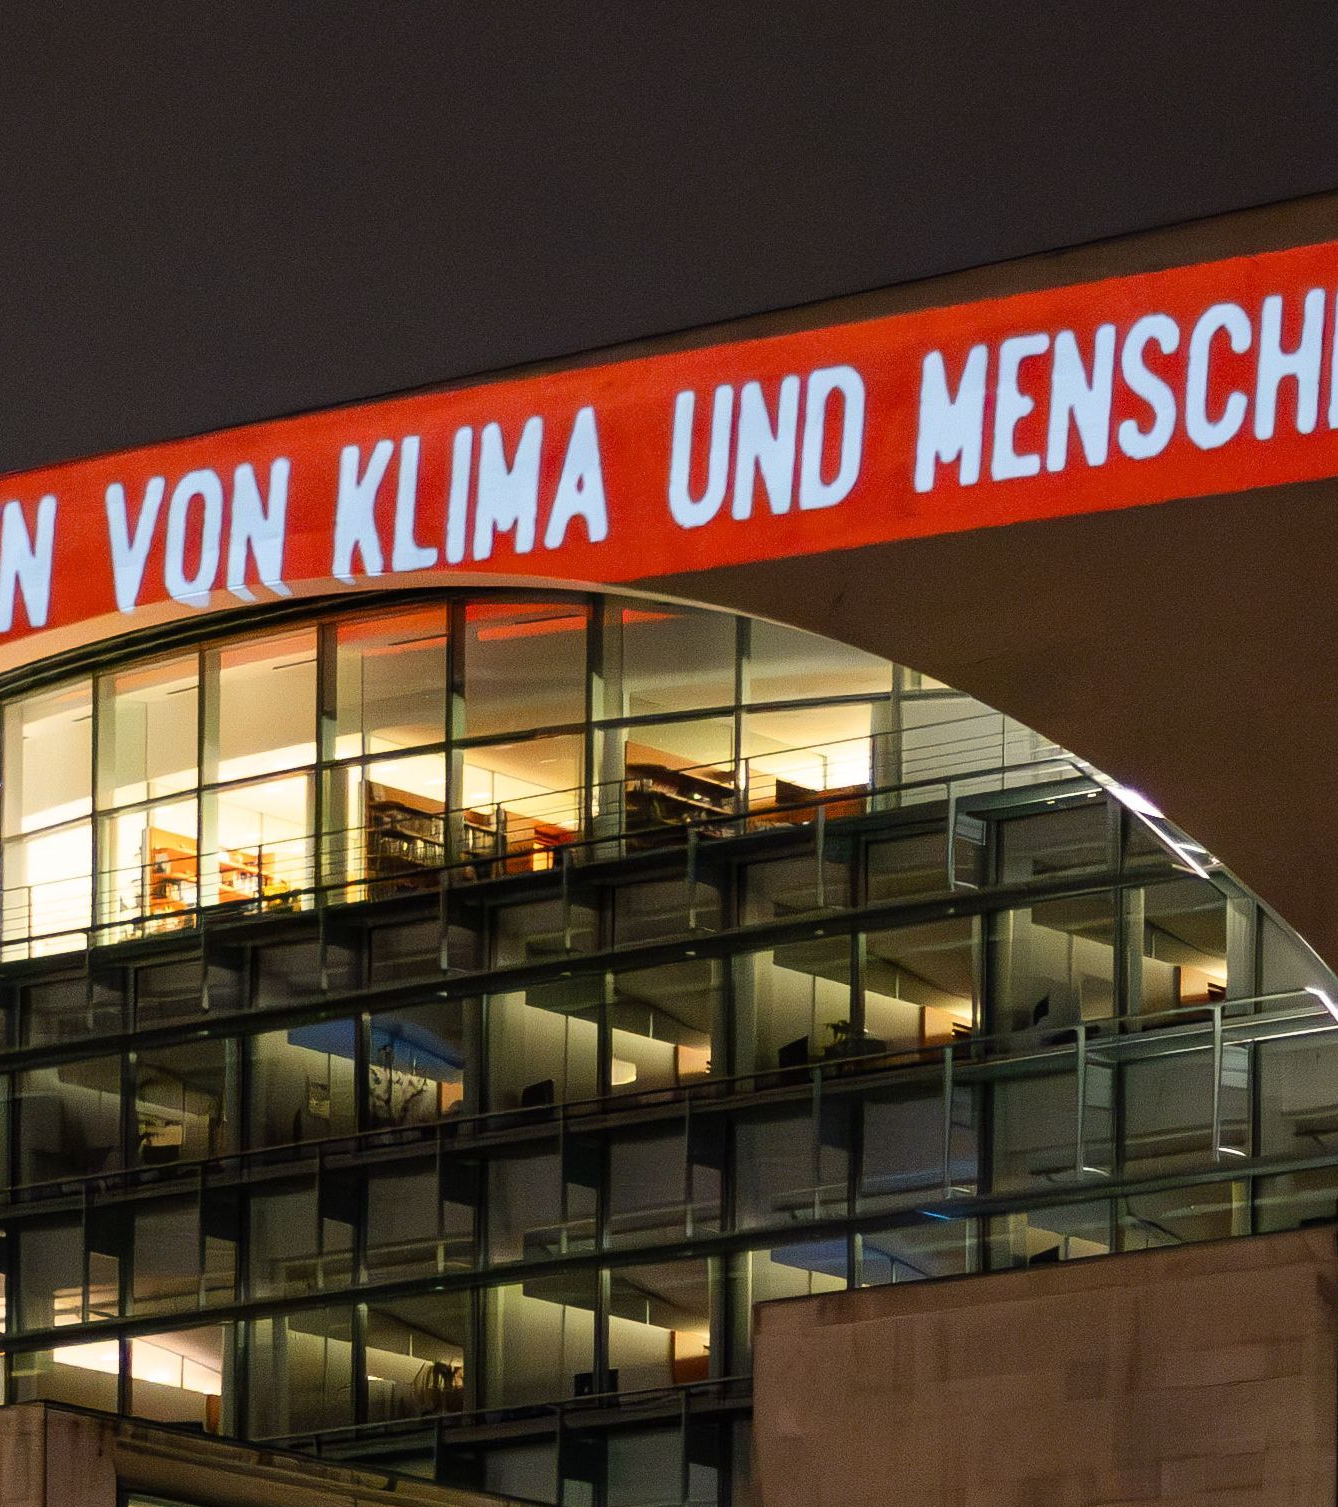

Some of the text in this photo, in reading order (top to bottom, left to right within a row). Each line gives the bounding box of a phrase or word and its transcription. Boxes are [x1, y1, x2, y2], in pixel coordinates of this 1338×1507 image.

[105, 456, 293, 613] VON
[332, 405, 609, 585] KLIMA
[667, 364, 866, 530] UND
